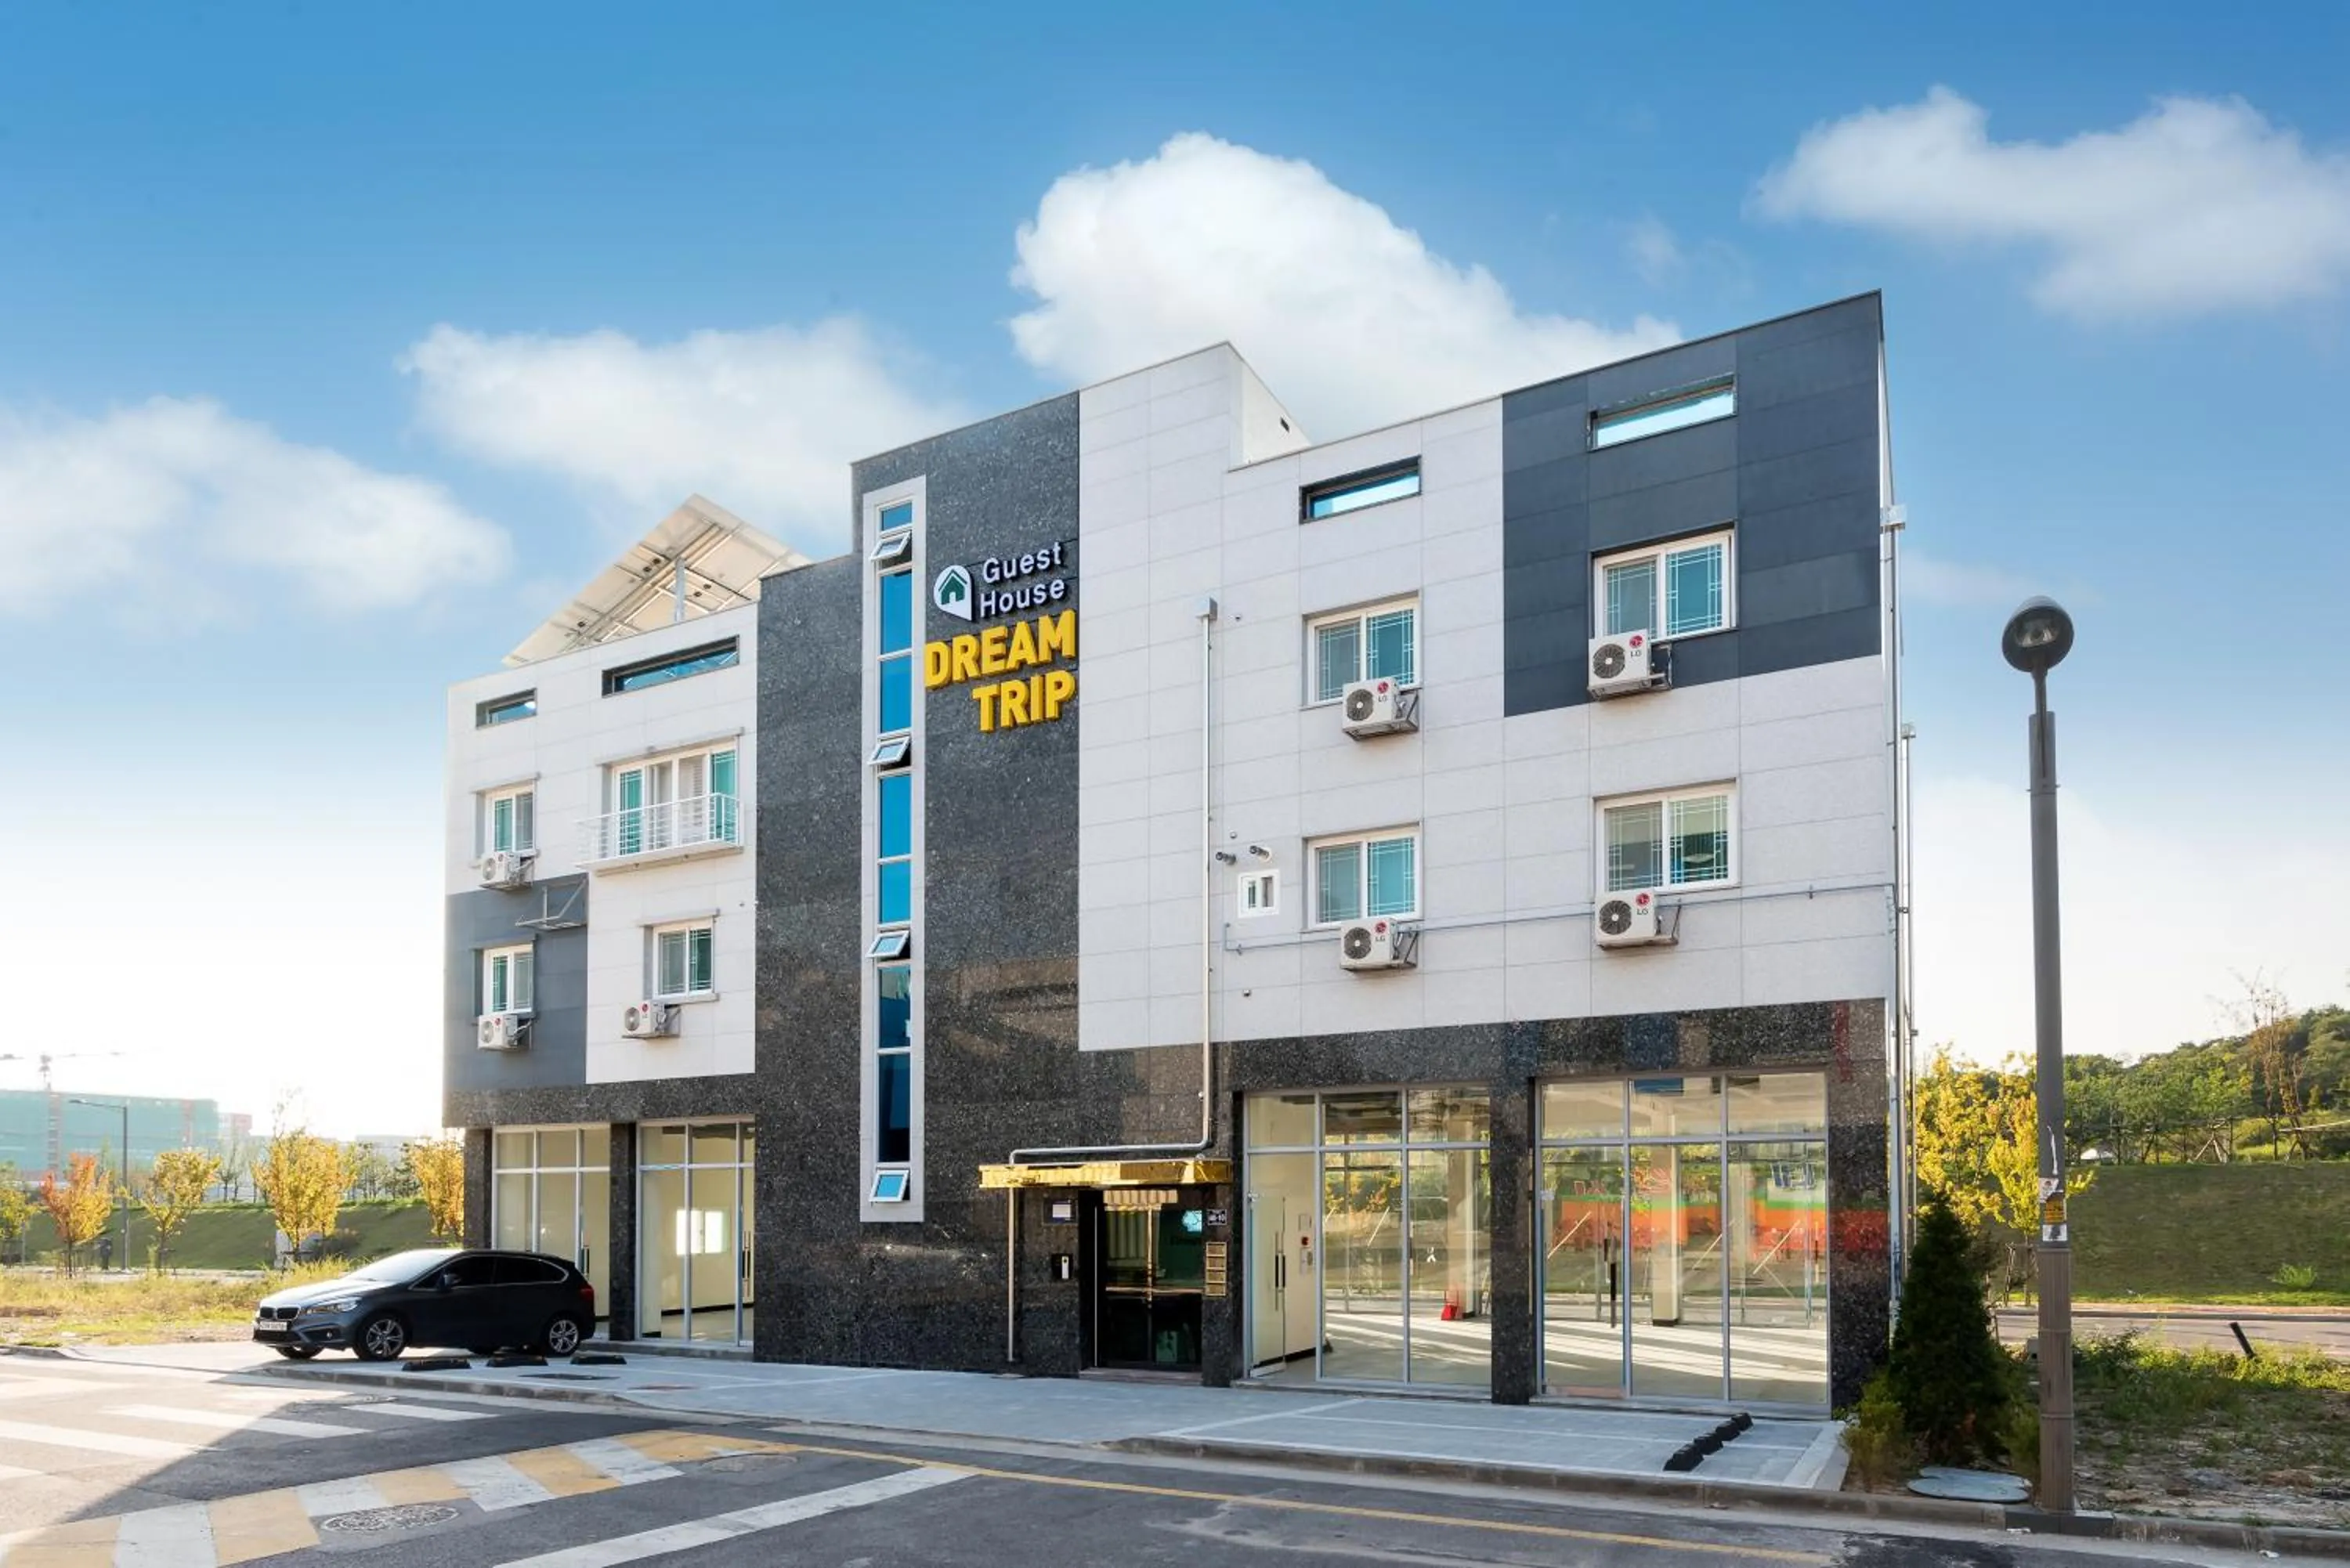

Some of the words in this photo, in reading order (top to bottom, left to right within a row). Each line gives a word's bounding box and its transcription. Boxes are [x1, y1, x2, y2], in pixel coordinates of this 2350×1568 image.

[983, 541, 1062, 583] Guest
[980, 578, 1065, 618] House
[924, 609, 1076, 690] DREAM
[973, 670, 1076, 732] TRIP
